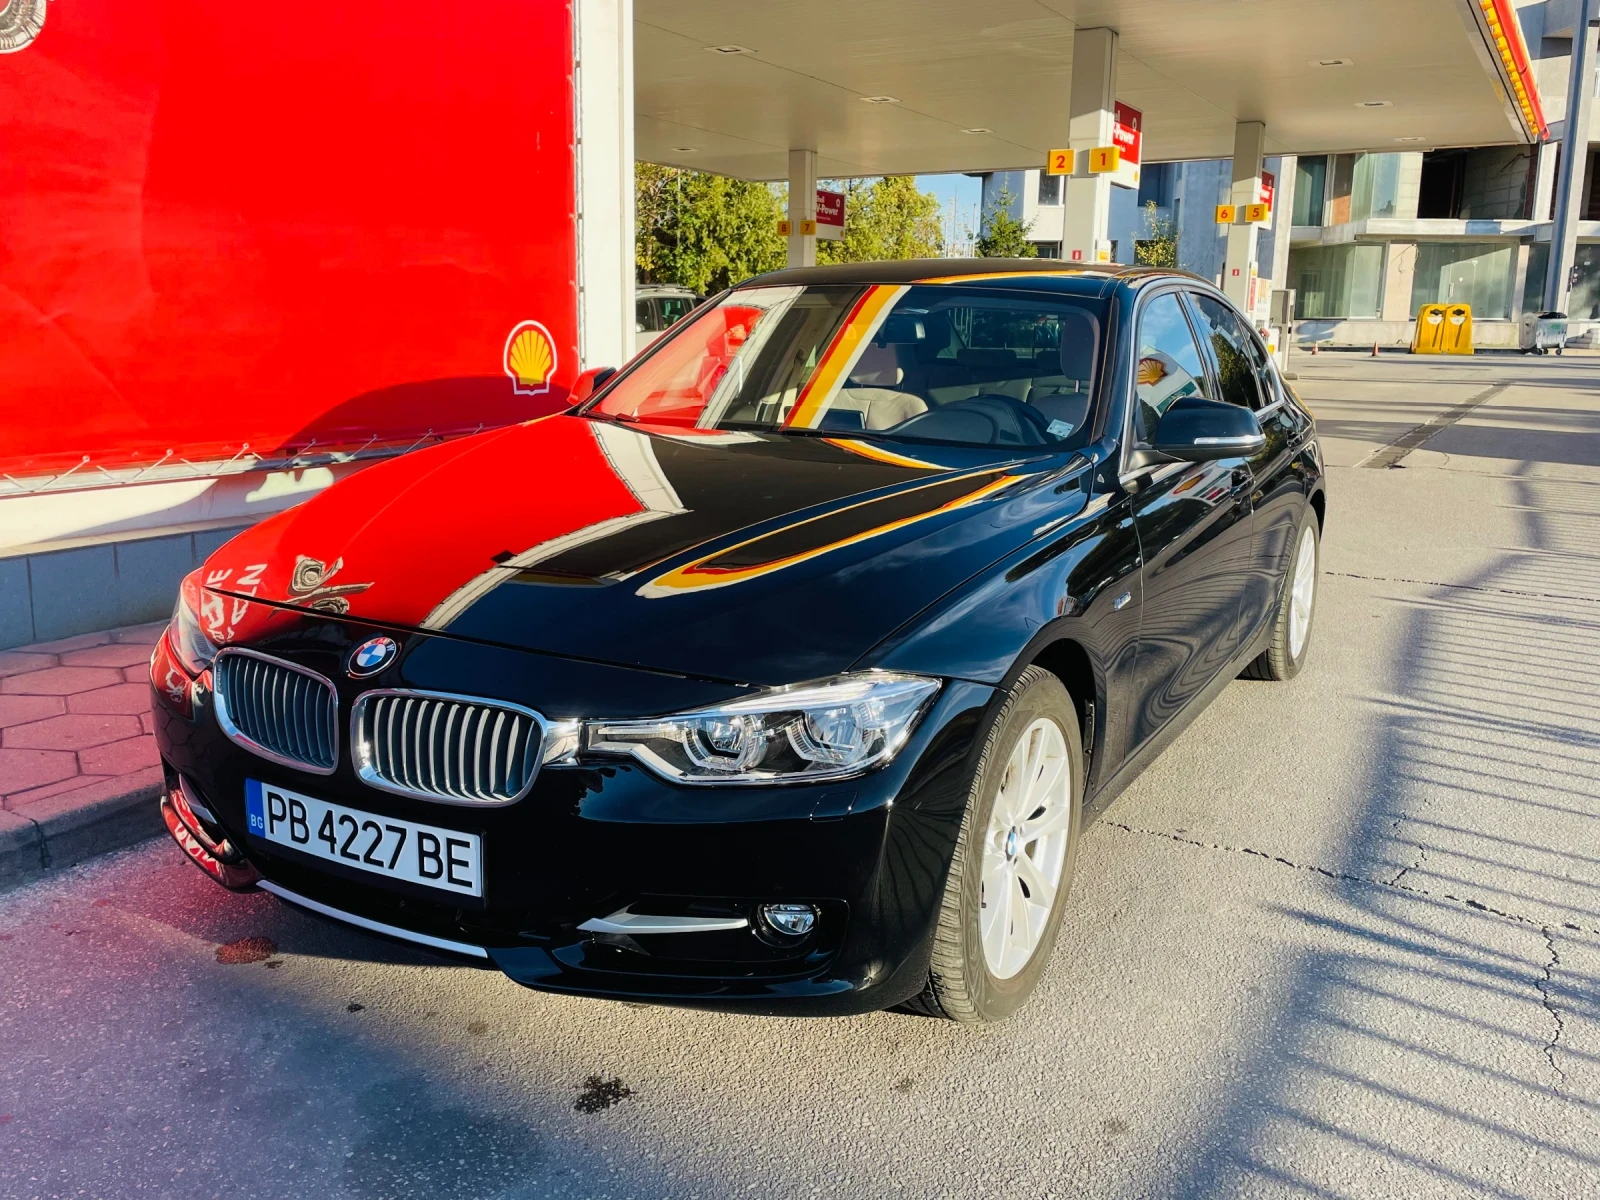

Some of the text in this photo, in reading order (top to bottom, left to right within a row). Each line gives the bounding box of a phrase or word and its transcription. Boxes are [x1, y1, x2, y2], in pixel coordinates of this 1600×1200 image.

[1056, 155, 1066, 169] 2
[1100, 153, 1106, 166] 1
[1220, 208, 1228, 219] 6
[1252, 207, 1260, 218] 5
[781, 224, 787, 232] 8
[805, 223, 810, 232] 7
[250, 813, 264, 830] BG
[267, 791, 473, 888] PB 4227 BE
